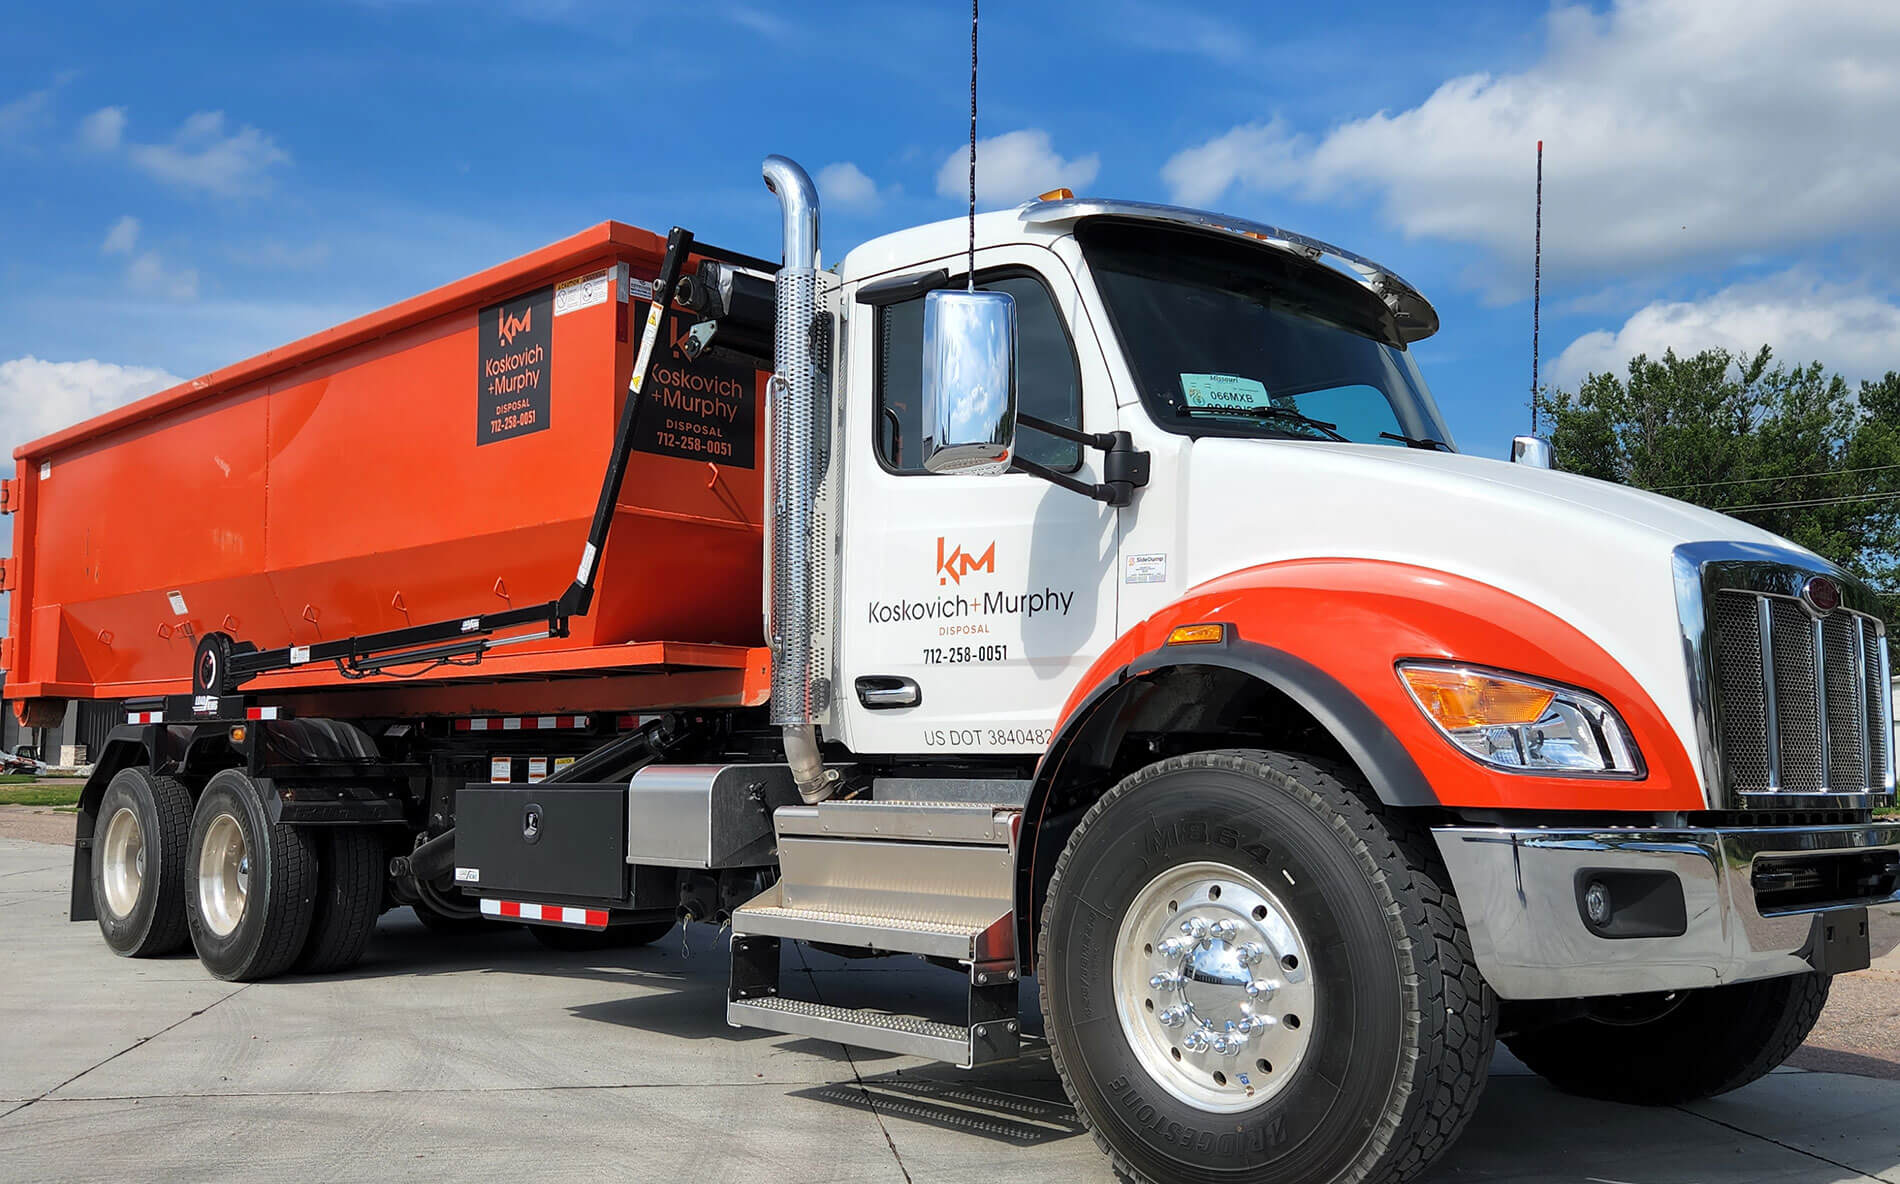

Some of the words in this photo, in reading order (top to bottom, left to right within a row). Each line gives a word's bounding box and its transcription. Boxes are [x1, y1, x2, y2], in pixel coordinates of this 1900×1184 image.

[485, 343, 544, 378] Koskovich
[1210, 375, 1239, 384] Missouri
[496, 398, 530, 416] DISPOSAL
[1210, 391, 1254, 403] 066MXB
[490, 409, 537, 434] 712-258-0051
[666, 418, 723, 438] DISPOSAL
[657, 431, 732, 457] 712-258-0051
[936, 536, 995, 586] KM
[938, 624, 990, 636] DISPOSAL
[923, 644, 1008, 665] 712-258-0051
[924, 730, 946, 746] US
[949, 730, 982, 746] DOT
